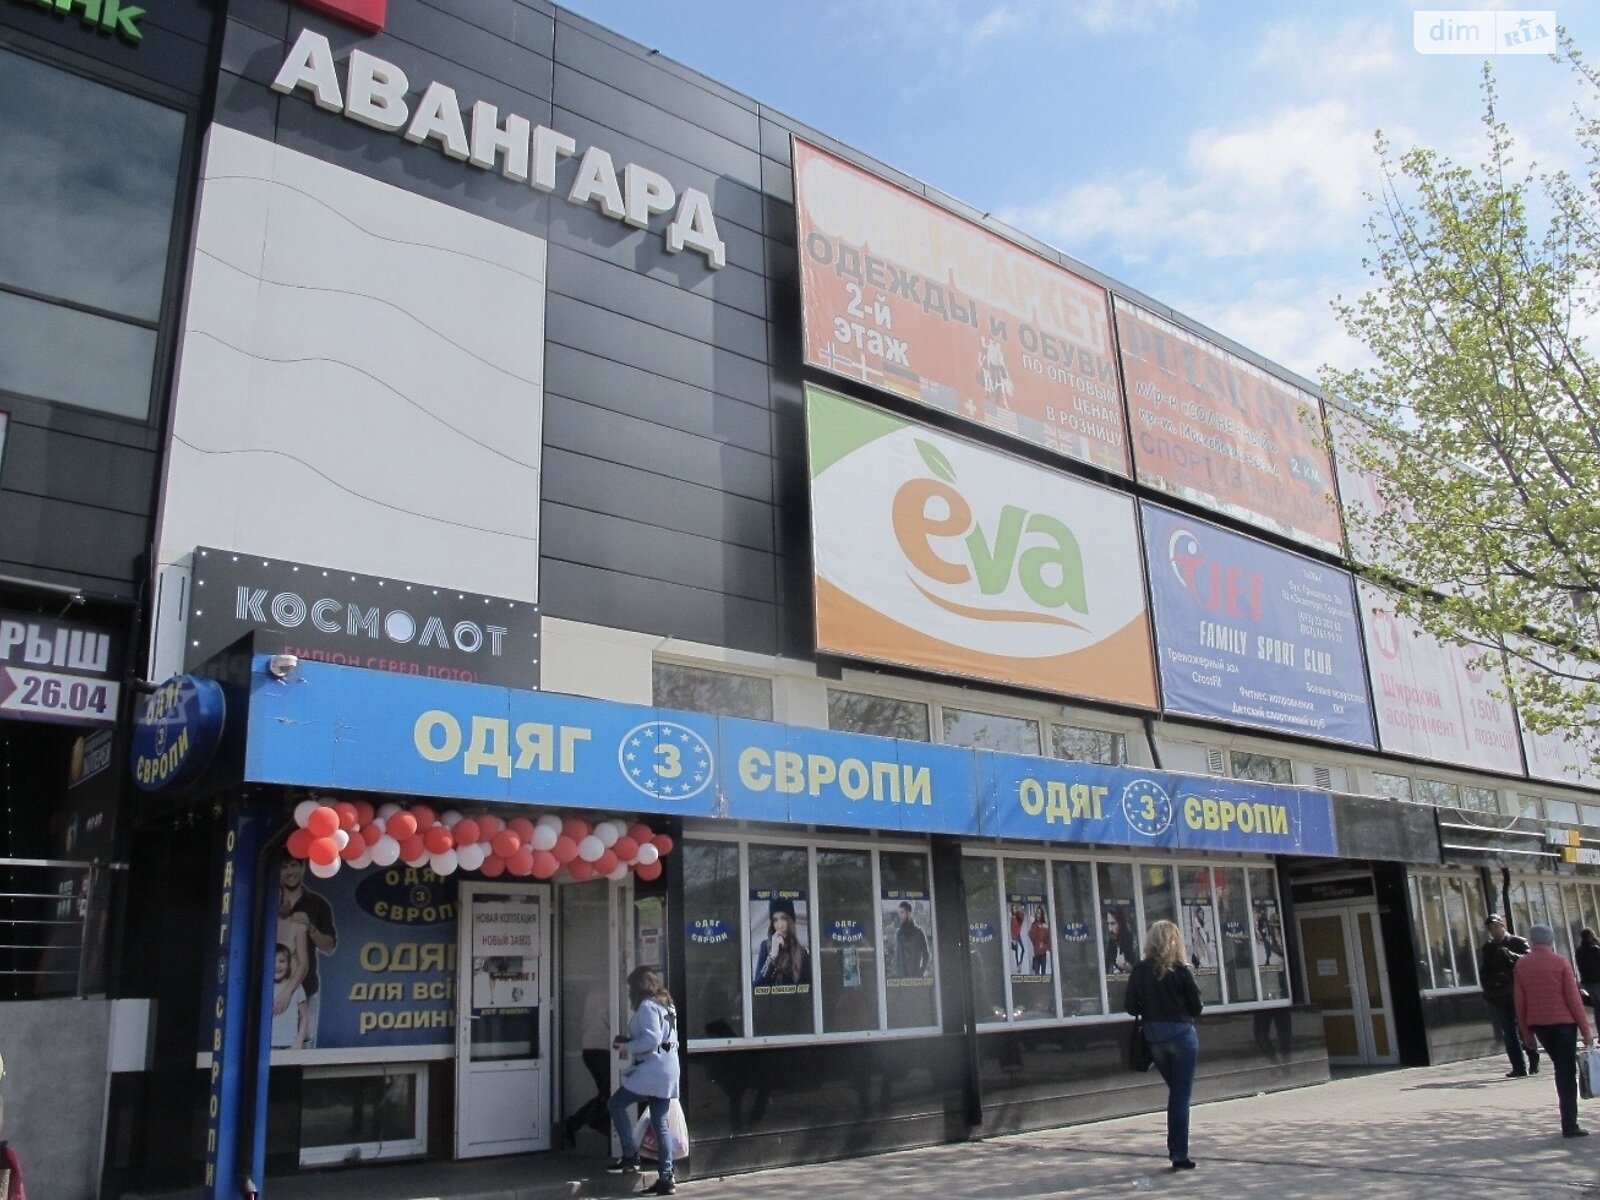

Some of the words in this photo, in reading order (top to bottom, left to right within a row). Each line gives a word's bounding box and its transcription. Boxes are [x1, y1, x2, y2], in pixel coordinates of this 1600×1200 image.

[271, 28, 726, 269] АВАНГАРД
[806, 232, 978, 328] ОДЕЖДЫ
[991, 316, 1008, 341] и
[1017, 322, 1117, 385] ОБУВИ
[846, 281, 892, 330] 2-й
[833, 316, 910, 367] этаж
[1022, 354, 1043, 375] ПО
[1048, 364, 1118, 404] ОПТОВЫМ
[1045, 405, 1056, 421] В
[1059, 409, 1122, 448] РОЗНИЦУ
[1072, 395, 1120, 427] ЦЕНАМ
[892, 478, 1089, 615] eva
[235, 586, 508, 656] КОСМОЛОТ
[0, 619, 110, 672] РЫШ
[1168, 648, 1225, 672] Тренажерный
[1200, 620, 1247, 656] FAMILY
[1258, 636, 1295, 667] SPORT
[1304, 648, 1332, 676] CLUB
[20, 676, 107, 714] 26.04
[1192, 671, 1221, 688] CrossFit
[1239, 686, 1268, 702] Фитнес
[1380, 673, 1441, 710] Широкий
[1232, 702, 1265, 718] Детский
[1386, 707, 1457, 739] асортимент
[1470, 699, 1501, 724] 1500
[137, 726, 188, 784] ЄВРОПИ
[414, 710, 592, 778] ОДЯГ
[738, 747, 932, 805] ЄВРОПИ
[1019, 780, 1109, 824] ОДЯГ
[1185, 797, 1288, 835] ЄВРОПИ
[219, 829, 236, 945] ОДЯГ
[374, 901, 458, 922] ЄВРОП
[476, 913, 498, 924] НОВАЯ
[500, 913, 536, 924] КОЛЛЕКЦИЯ
[695, 919, 720, 928] ОДЯГ
[482, 932, 508, 946] НОВЫЙ
[510, 935, 532, 946] ЗАВОЗ
[350, 982, 403, 1001] для
[413, 979, 457, 1000] всі
